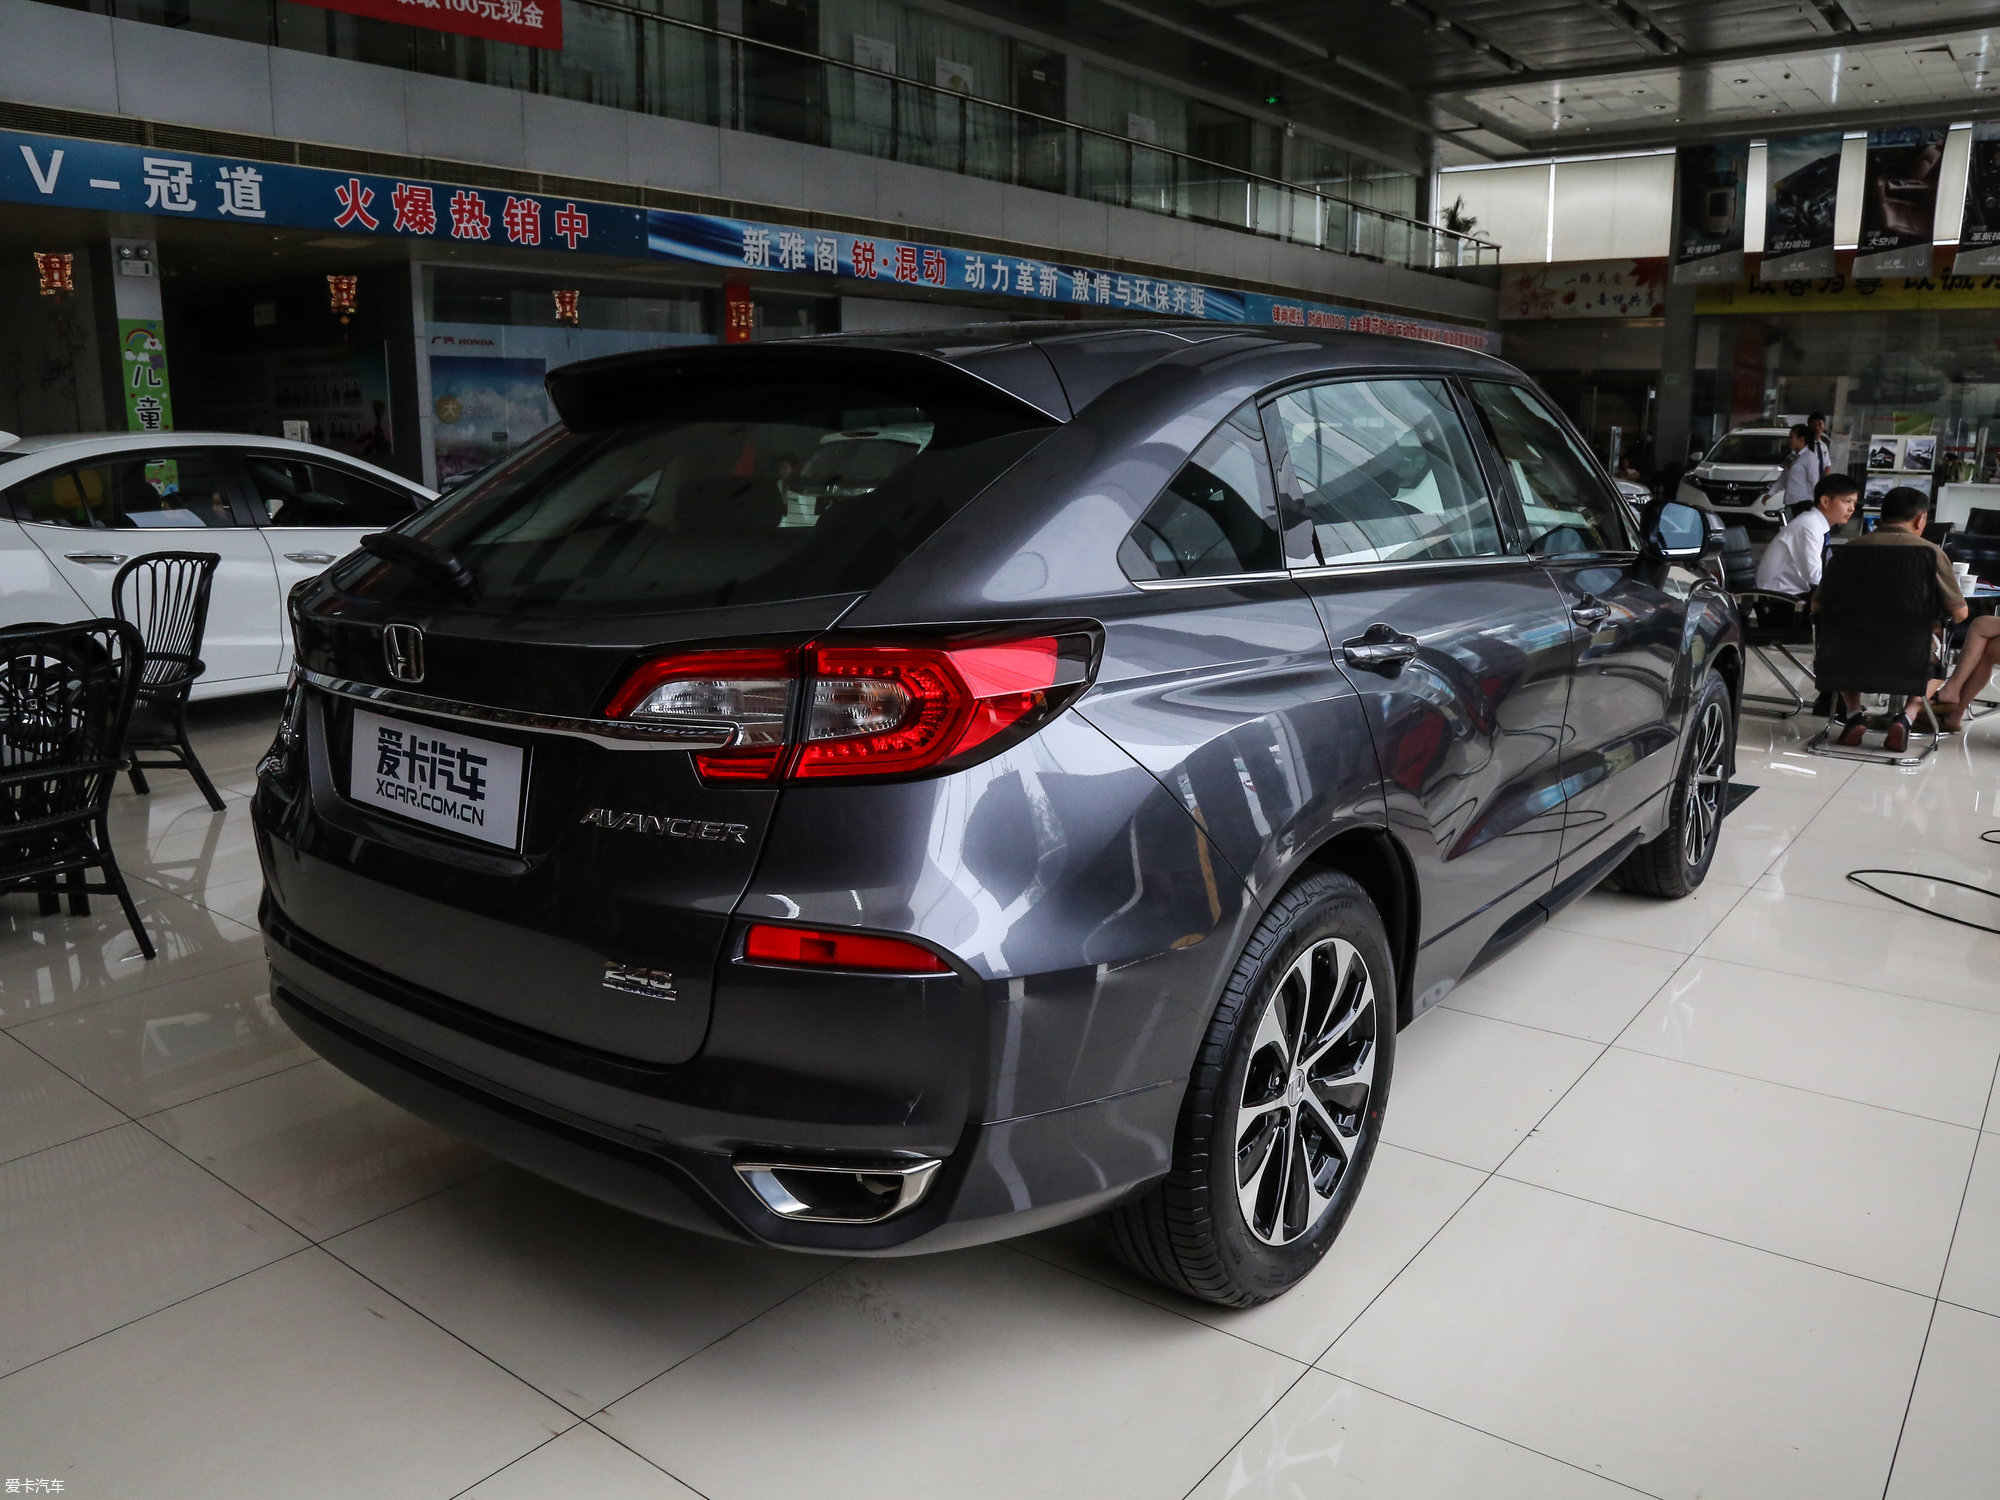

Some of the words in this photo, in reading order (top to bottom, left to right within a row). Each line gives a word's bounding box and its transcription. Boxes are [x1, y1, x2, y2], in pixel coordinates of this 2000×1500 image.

[396, 0, 545, 29] 100元现金
[333, 178, 591, 250] 火爆热销中
[1868, 236, 1899, 247] 大空间
[742, 226, 839, 275] 新雅阁
[963, 254, 1058, 299] 动力革新
[1071, 269, 1207, 316] 激情与环保齐驱
[458, 338, 495, 346] HONDA
[375, 726, 488, 801] 爱卡汽车
[375, 777, 485, 827] XCAR.COM.CN
[580, 807, 749, 844] AVANCIER
